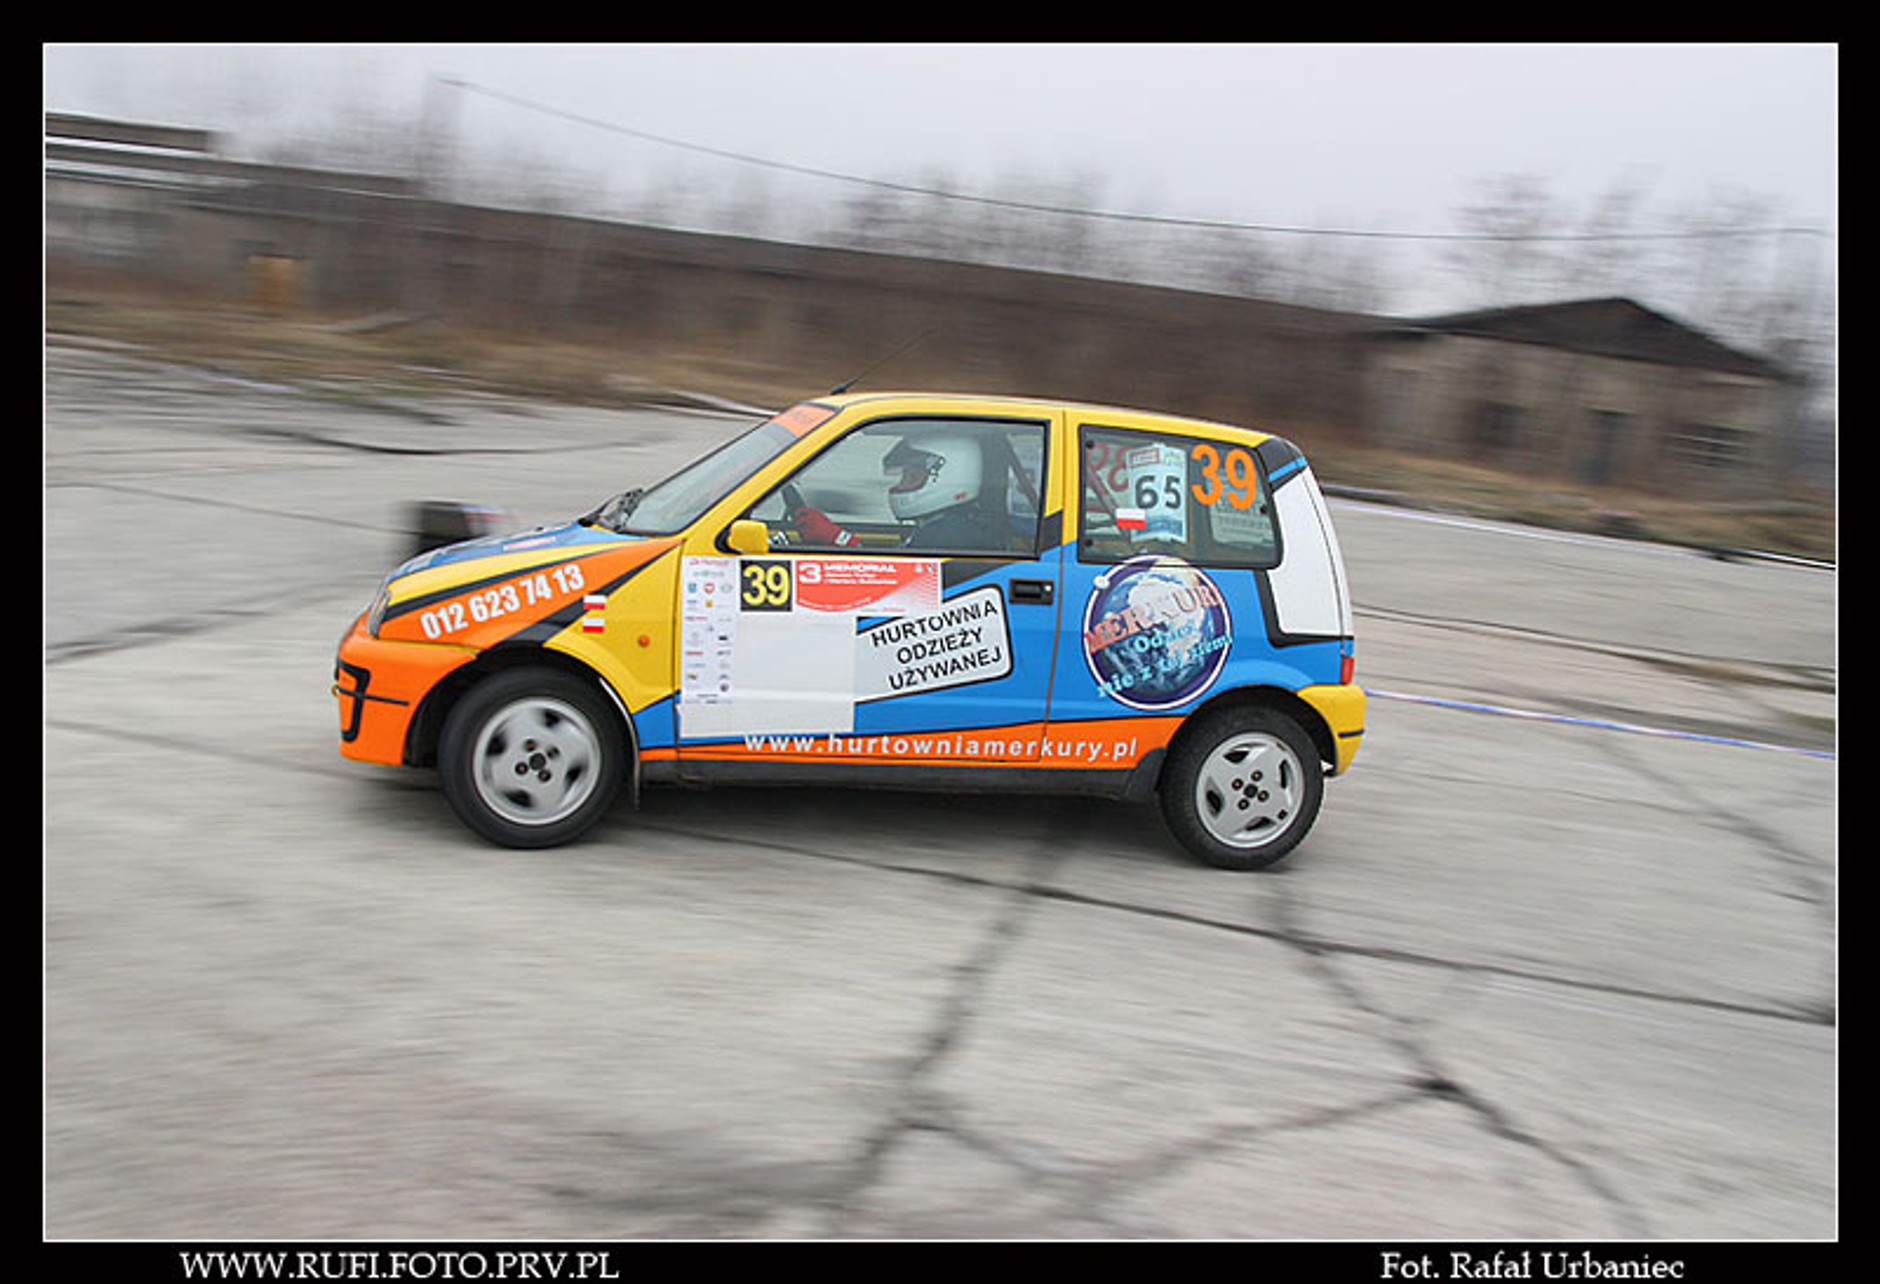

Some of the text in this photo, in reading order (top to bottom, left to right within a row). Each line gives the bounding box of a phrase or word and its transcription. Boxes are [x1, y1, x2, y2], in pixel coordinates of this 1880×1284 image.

[1135, 475, 1180, 509] 65
[1191, 444, 1257, 510] 39
[742, 564, 791, 607] 39
[799, 563, 822, 584] 3
[420, 564, 585, 640] 012 623 74 13
[871, 599, 998, 648] HURTOWNIA
[897, 627, 982, 665] ODZIEŻY
[888, 646, 1002, 690] UŻYWANEJ
[1140, 666, 1153, 681] z
[744, 734, 1137, 763] www.hurtowniamerkury.pl
